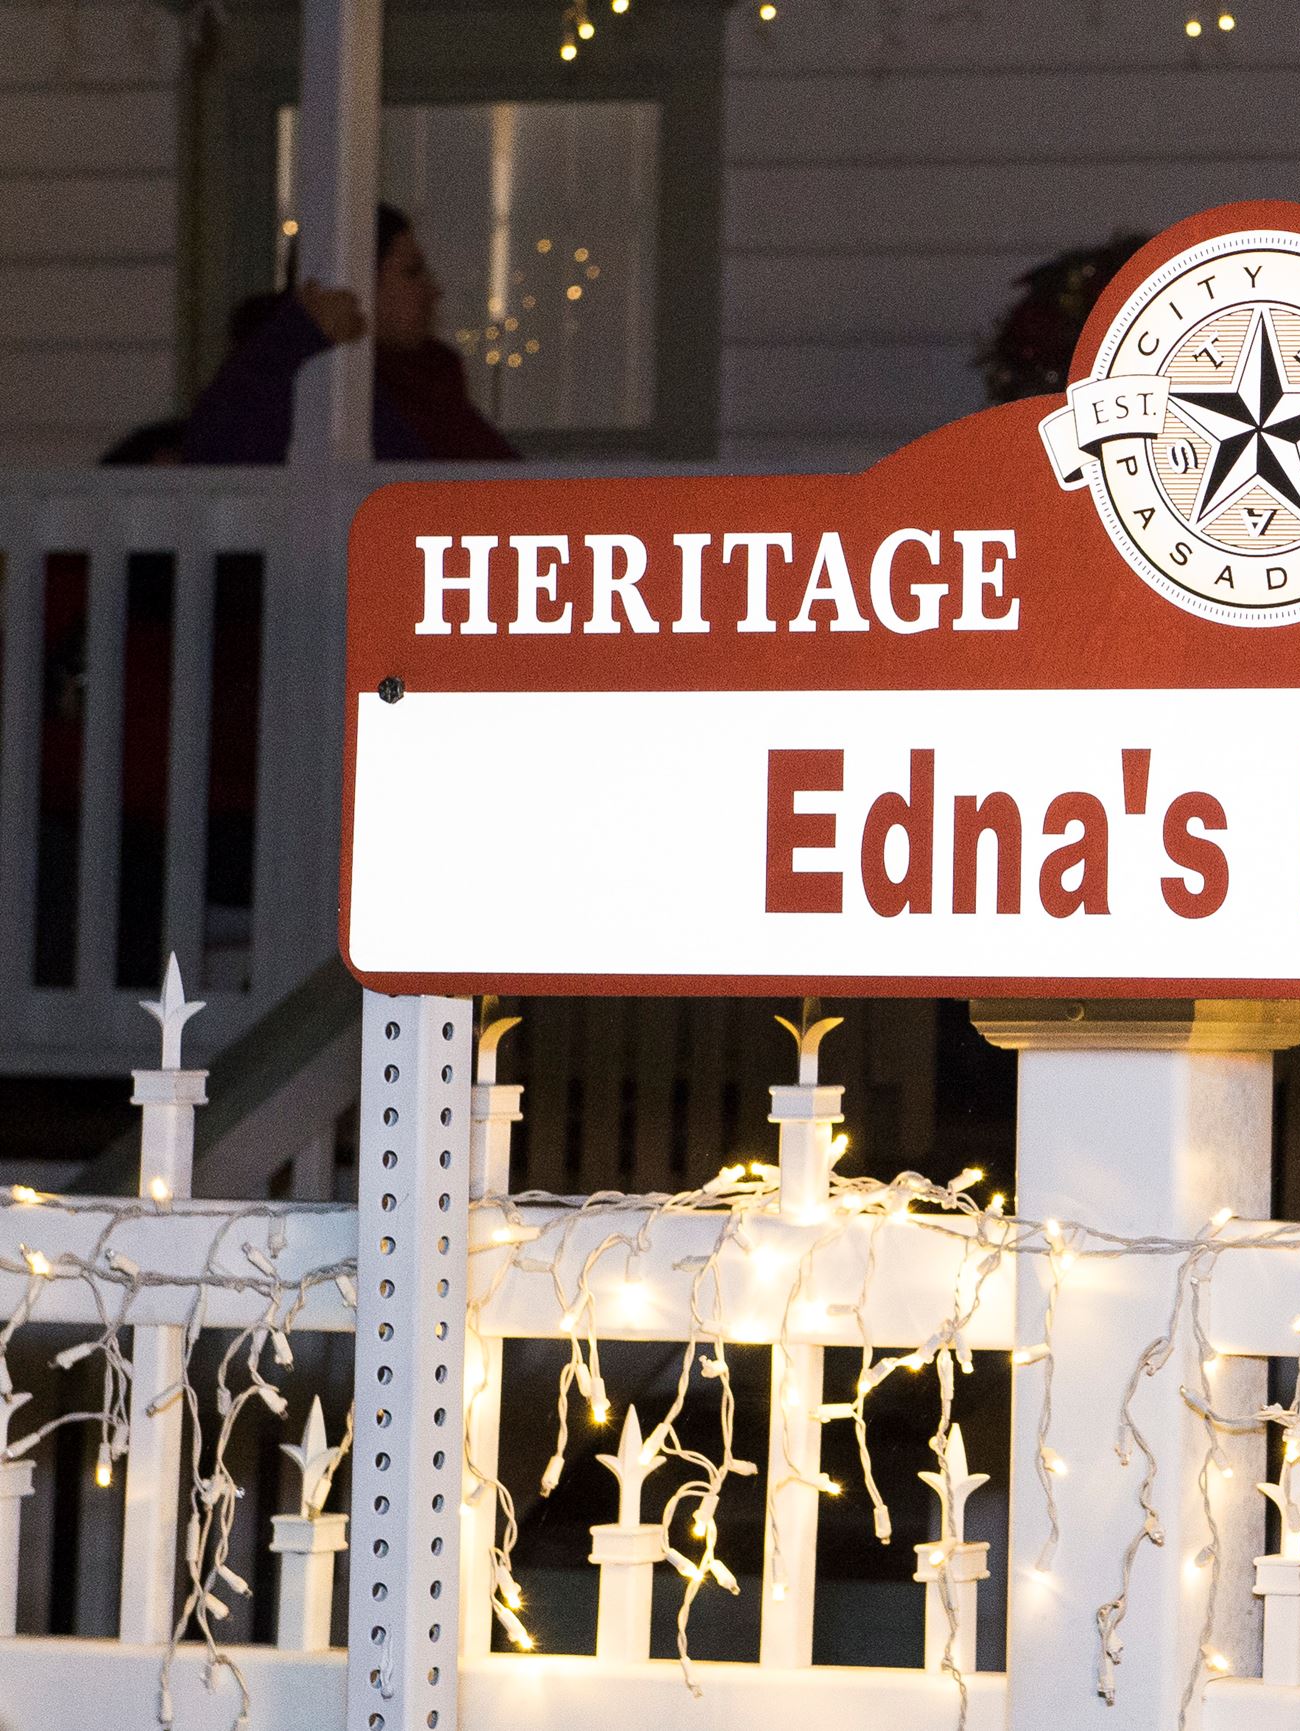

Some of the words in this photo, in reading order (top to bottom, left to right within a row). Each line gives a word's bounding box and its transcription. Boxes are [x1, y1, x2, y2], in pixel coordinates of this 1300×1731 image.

[1138, 266, 1263, 356] CITY
[1093, 392, 1157, 425] EST.
[414, 528, 1020, 635] HERITAGE
[764, 748, 1230, 920] Edna's
